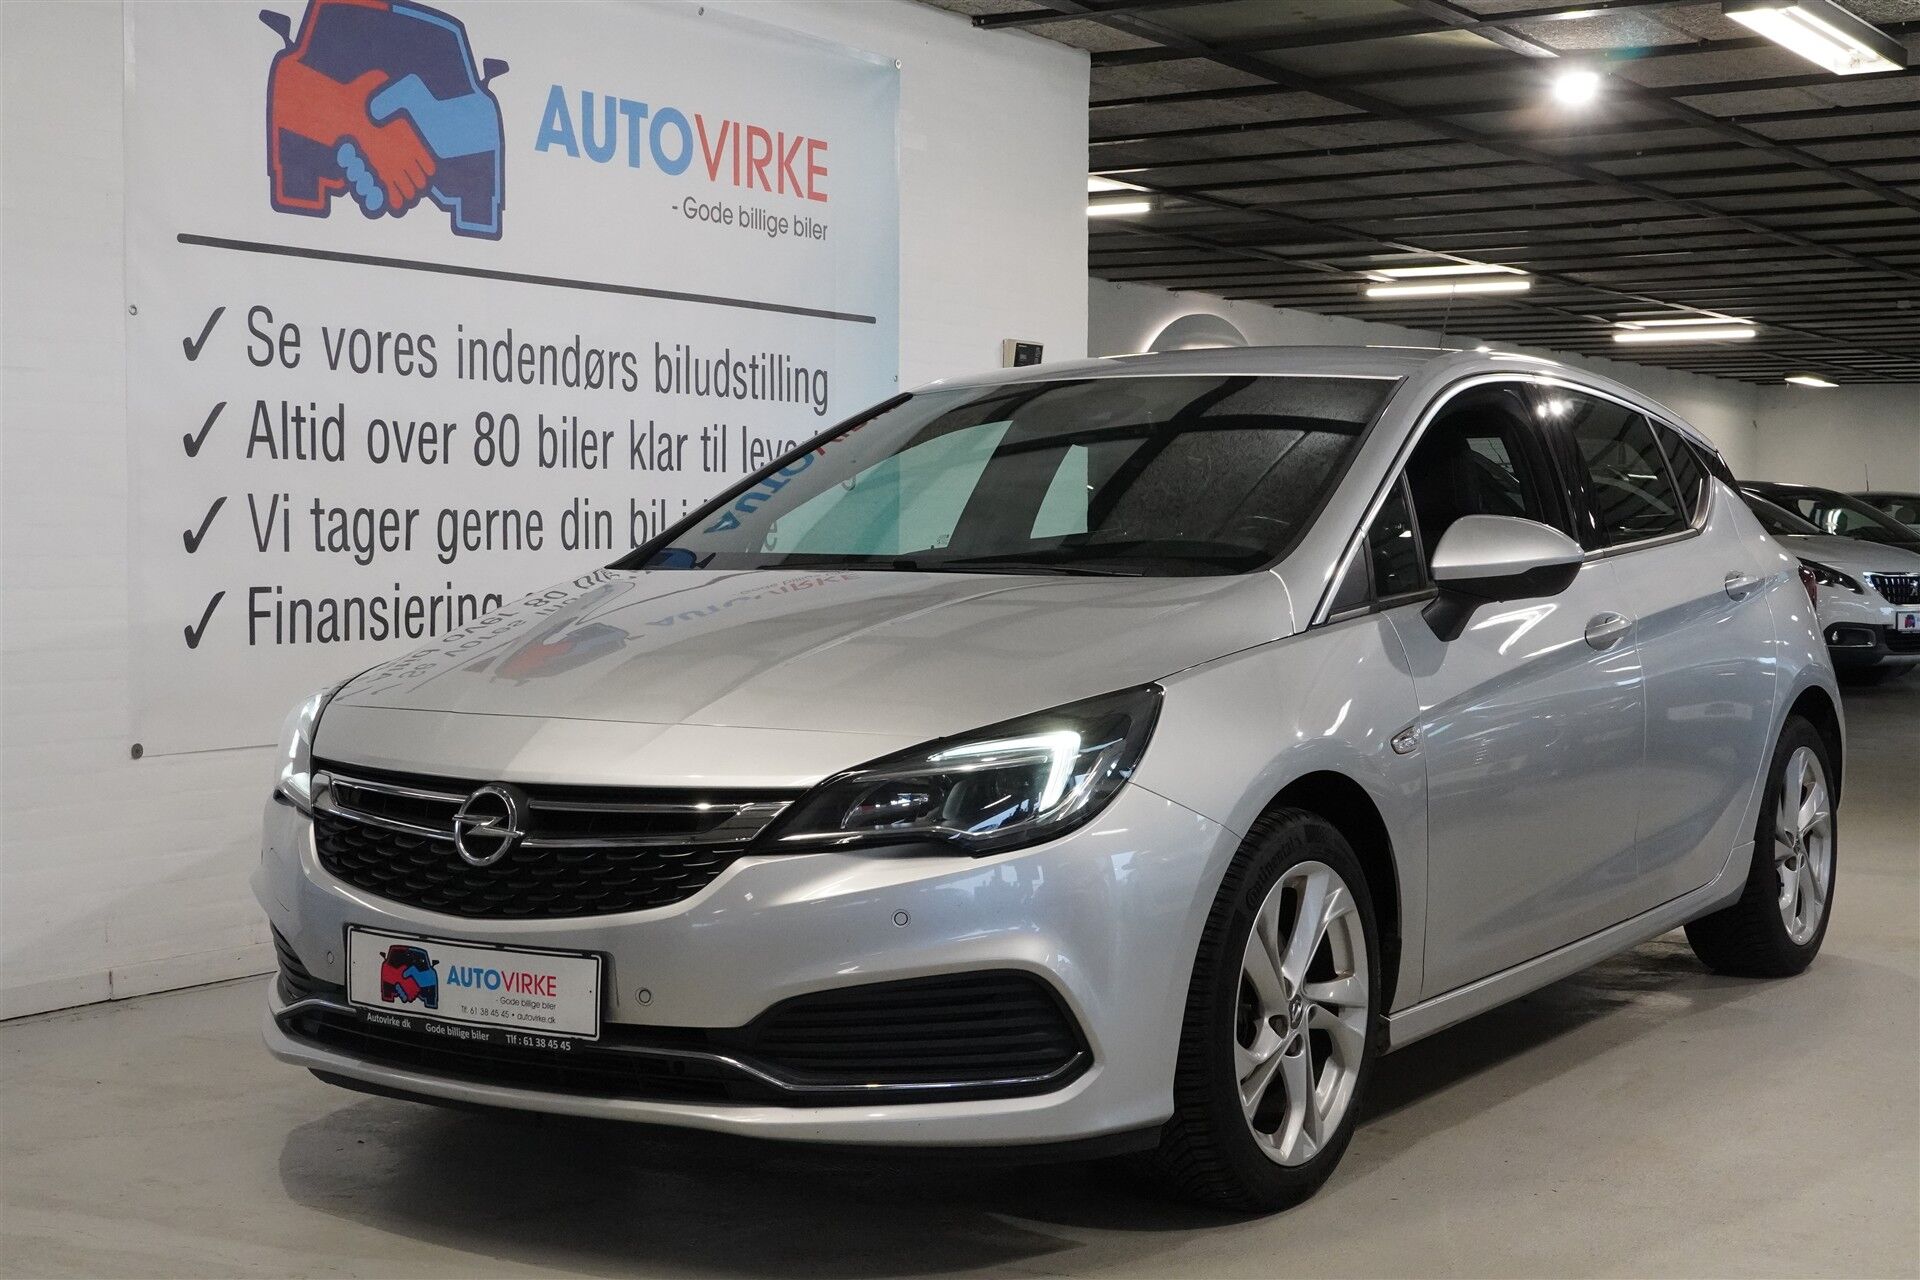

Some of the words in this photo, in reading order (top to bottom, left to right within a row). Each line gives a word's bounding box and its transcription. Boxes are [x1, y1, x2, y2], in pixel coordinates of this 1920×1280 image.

[535, 84, 828, 203] AUTOVIRKE
[683, 196, 733, 226] Gode
[739, 205, 788, 238] billige
[794, 214, 828, 241] biler
[247, 305, 301, 368] Se
[321, 326, 438, 379] vores
[457, 323, 638, 392] indendørs
[655, 342, 828, 416] biludstilling
[247, 399, 345, 463] Altid
[367, 418, 457, 465] over
[474, 411, 520, 468] 80
[538, 413, 614, 470] biler
[629, 419, 688, 472] klar
[700, 423, 727, 473] til
[248, 493, 290, 553] Vi
[309, 498, 420, 566] tager
[438, 508, 544, 565] gerne
[560, 496, 613, 551] din
[630, 498, 666, 550] bil
[447, 965, 557, 997] AUTOVIRKE
[480, 1007, 489, 1017] 38
[491, 1009, 500, 1018] 45
[501, 1010, 510, 1019] 45
[500, 996, 520, 1006] Gode
[425, 1022, 446, 1035] Gode
[446, 1026, 470, 1040] billige
[471, 1029, 490, 1041] biler
[523, 1036, 534, 1047] 61
[535, 1037, 546, 1048] 38
[547, 1039, 559, 1050] 45
[560, 1041, 572, 1051] 45
